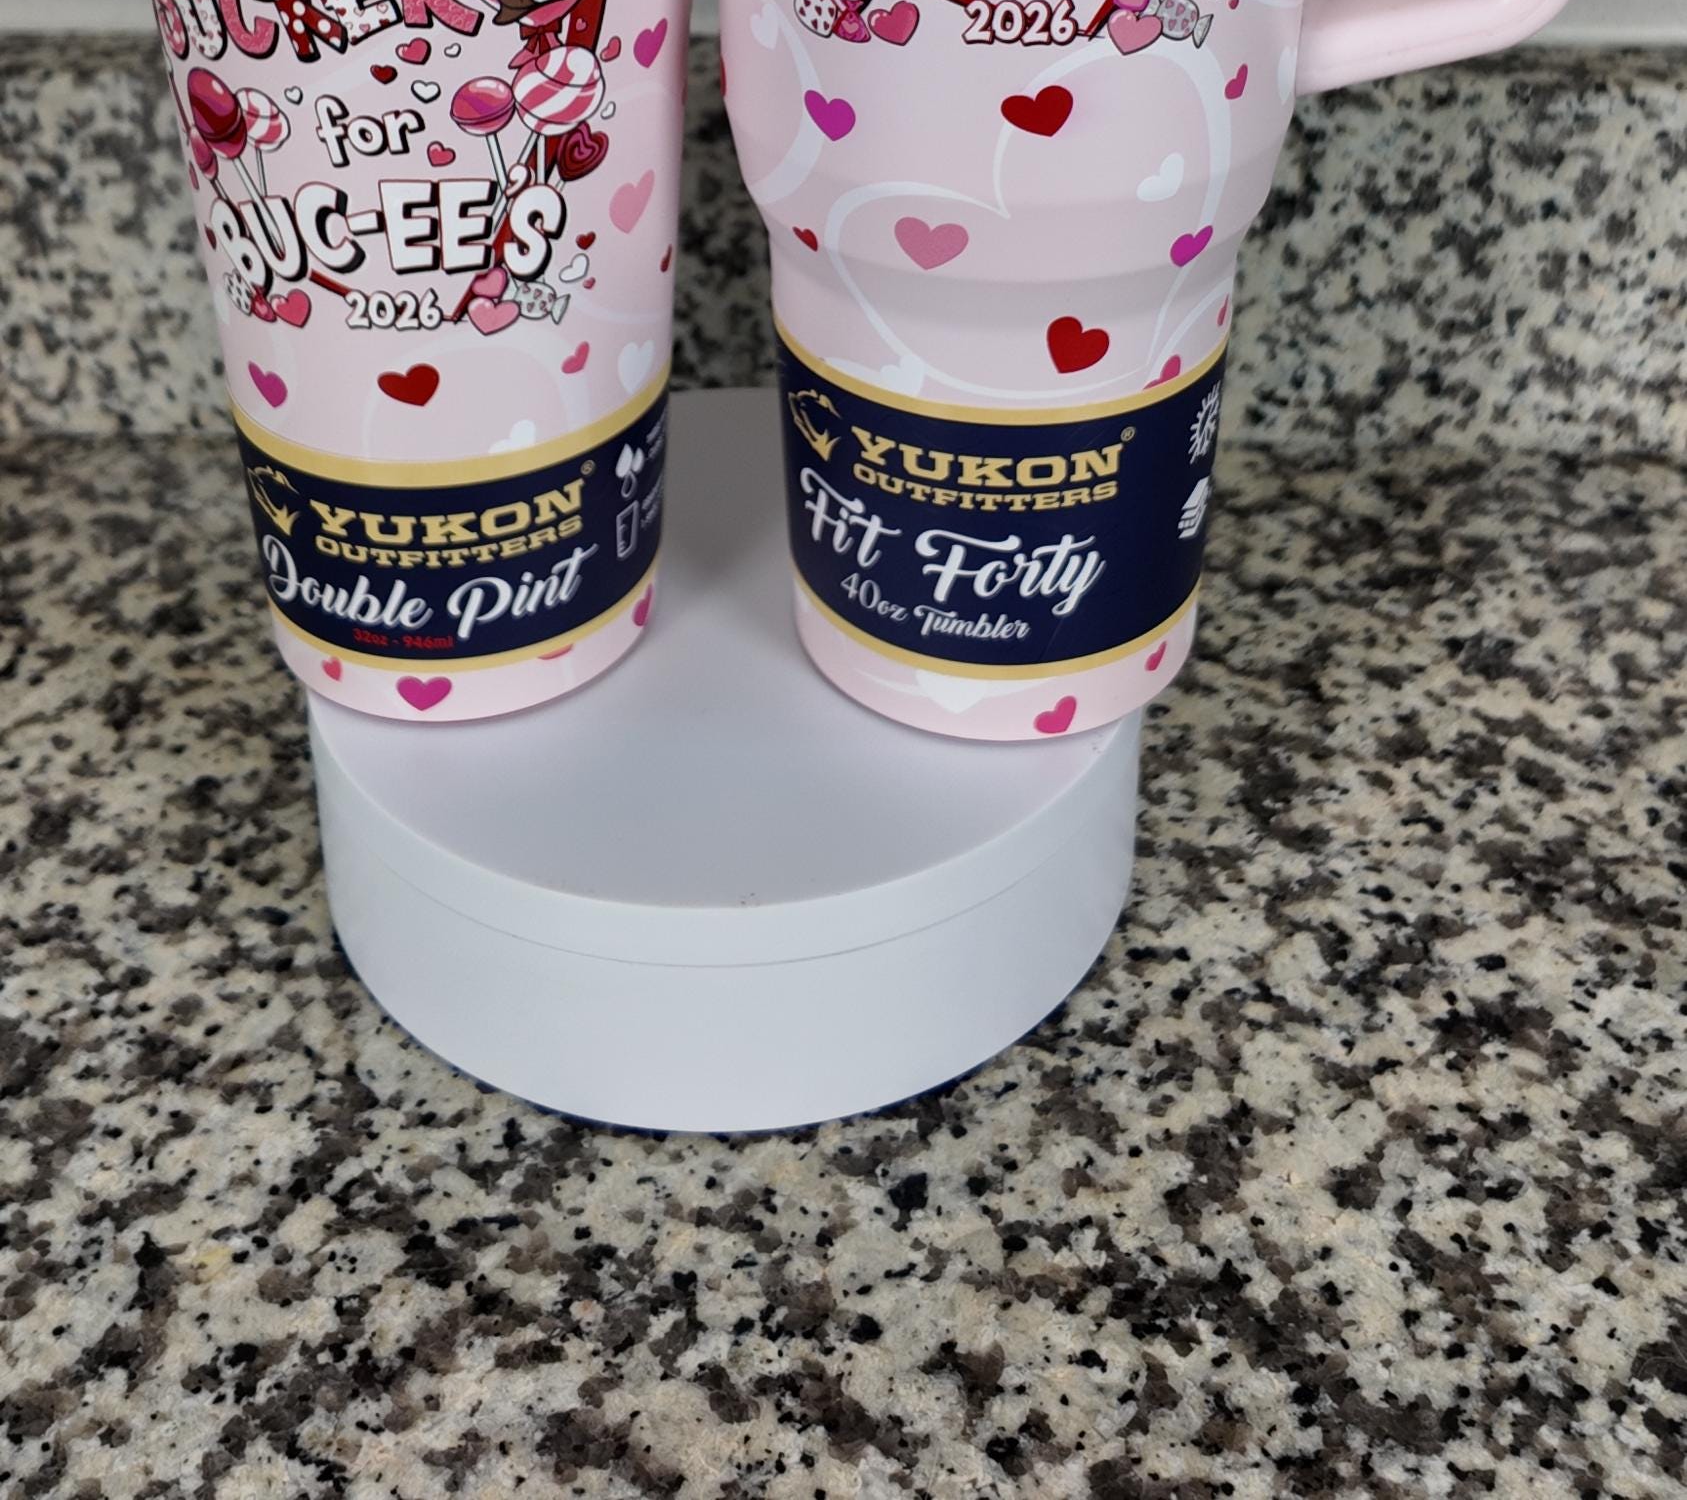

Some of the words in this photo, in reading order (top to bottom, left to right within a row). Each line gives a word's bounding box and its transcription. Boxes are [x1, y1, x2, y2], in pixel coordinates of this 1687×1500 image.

[315, 94, 424, 167] for
[210, 163, 566, 290] BUC-EE'S
[345, 289, 445, 330] 2026
[851, 425, 1124, 487] YUKON
[852, 463, 1118, 512] OUTFITTERS
[309, 477, 586, 546] YUKON
[315, 514, 584, 569] OUTFITTERS
[799, 467, 901, 568] Fit
[914, 528, 1105, 617] Forty
[261, 533, 434, 629] Double
[446, 542, 599, 641] Pint
[840, 572, 908, 622] 40oz
[913, 604, 1032, 640] Tumbler
[353, 627, 389, 647] 32oz
